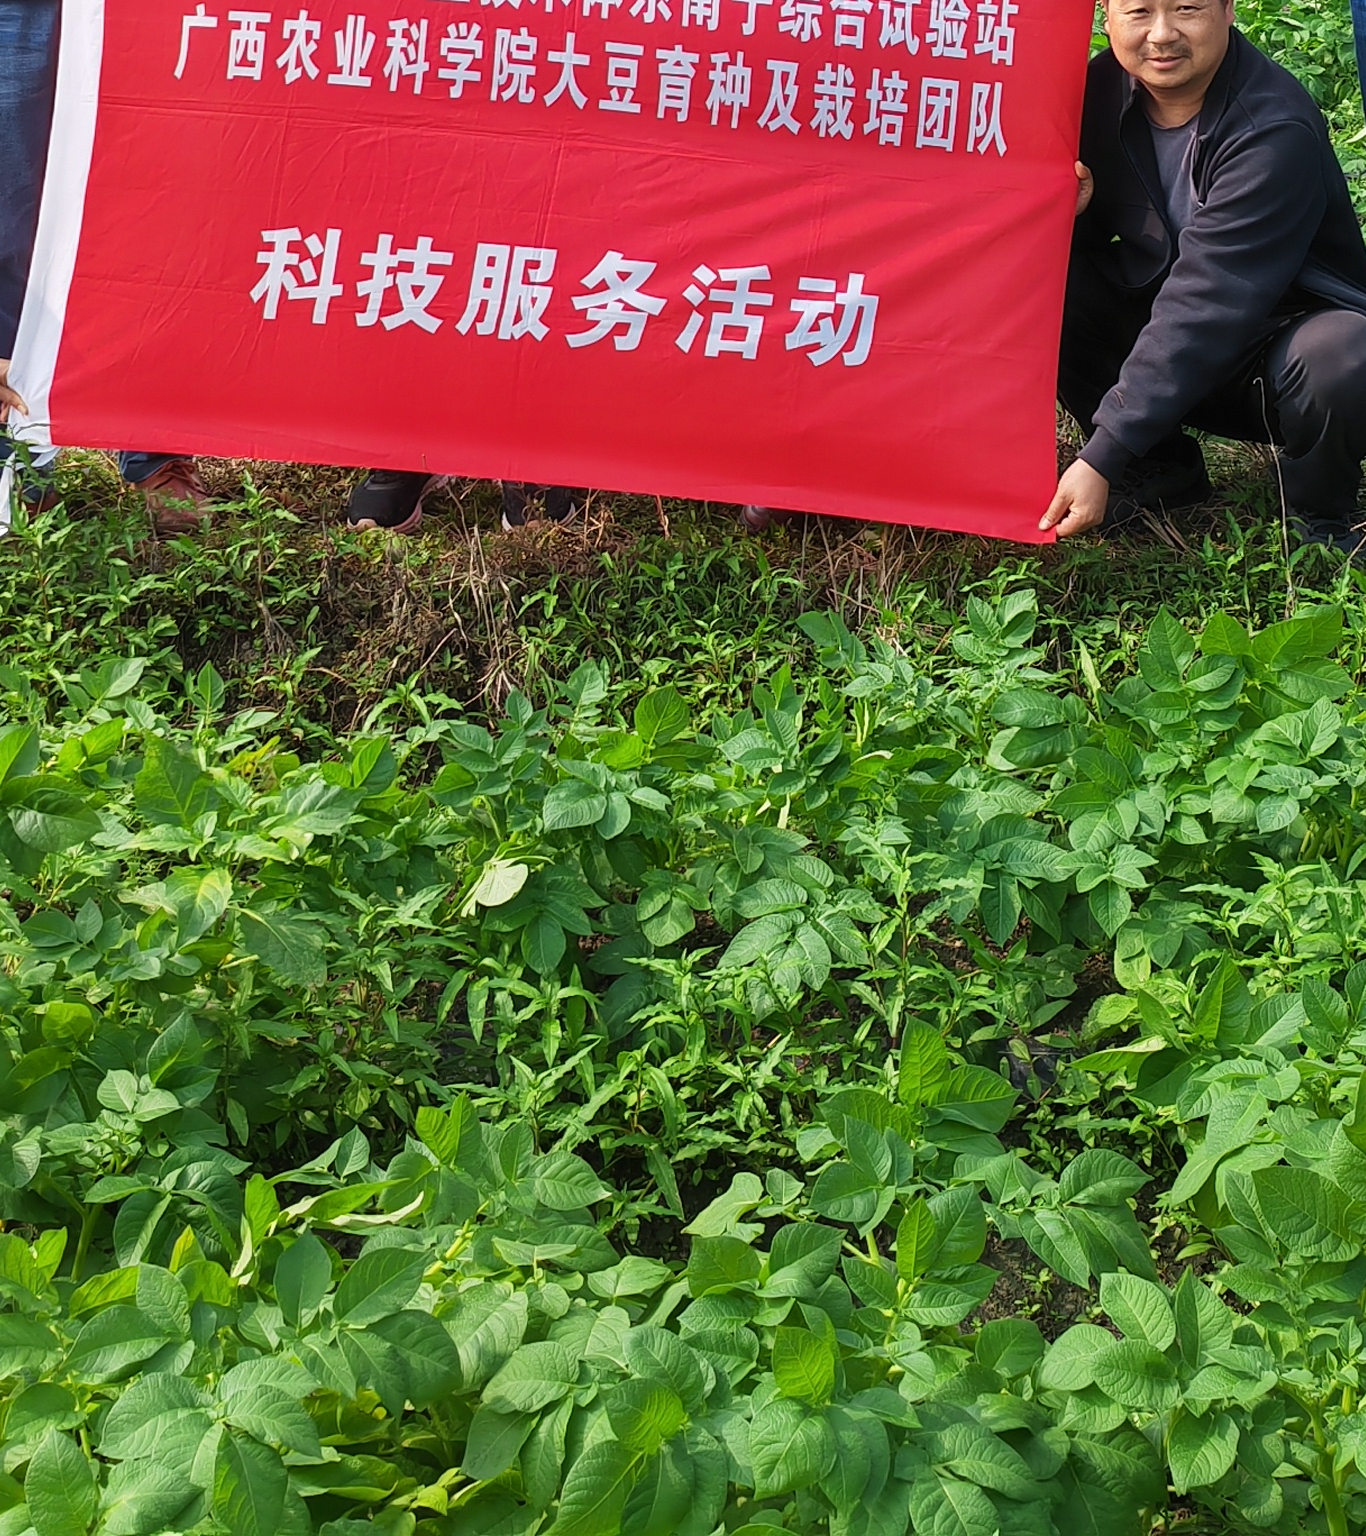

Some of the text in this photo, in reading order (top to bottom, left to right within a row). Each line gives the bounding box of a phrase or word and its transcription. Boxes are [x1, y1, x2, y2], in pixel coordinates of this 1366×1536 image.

[173, 3, 1007, 157] 广西农业科学院大豆育种及栽培团队
[249, 227, 879, 367] 科技服务活动
